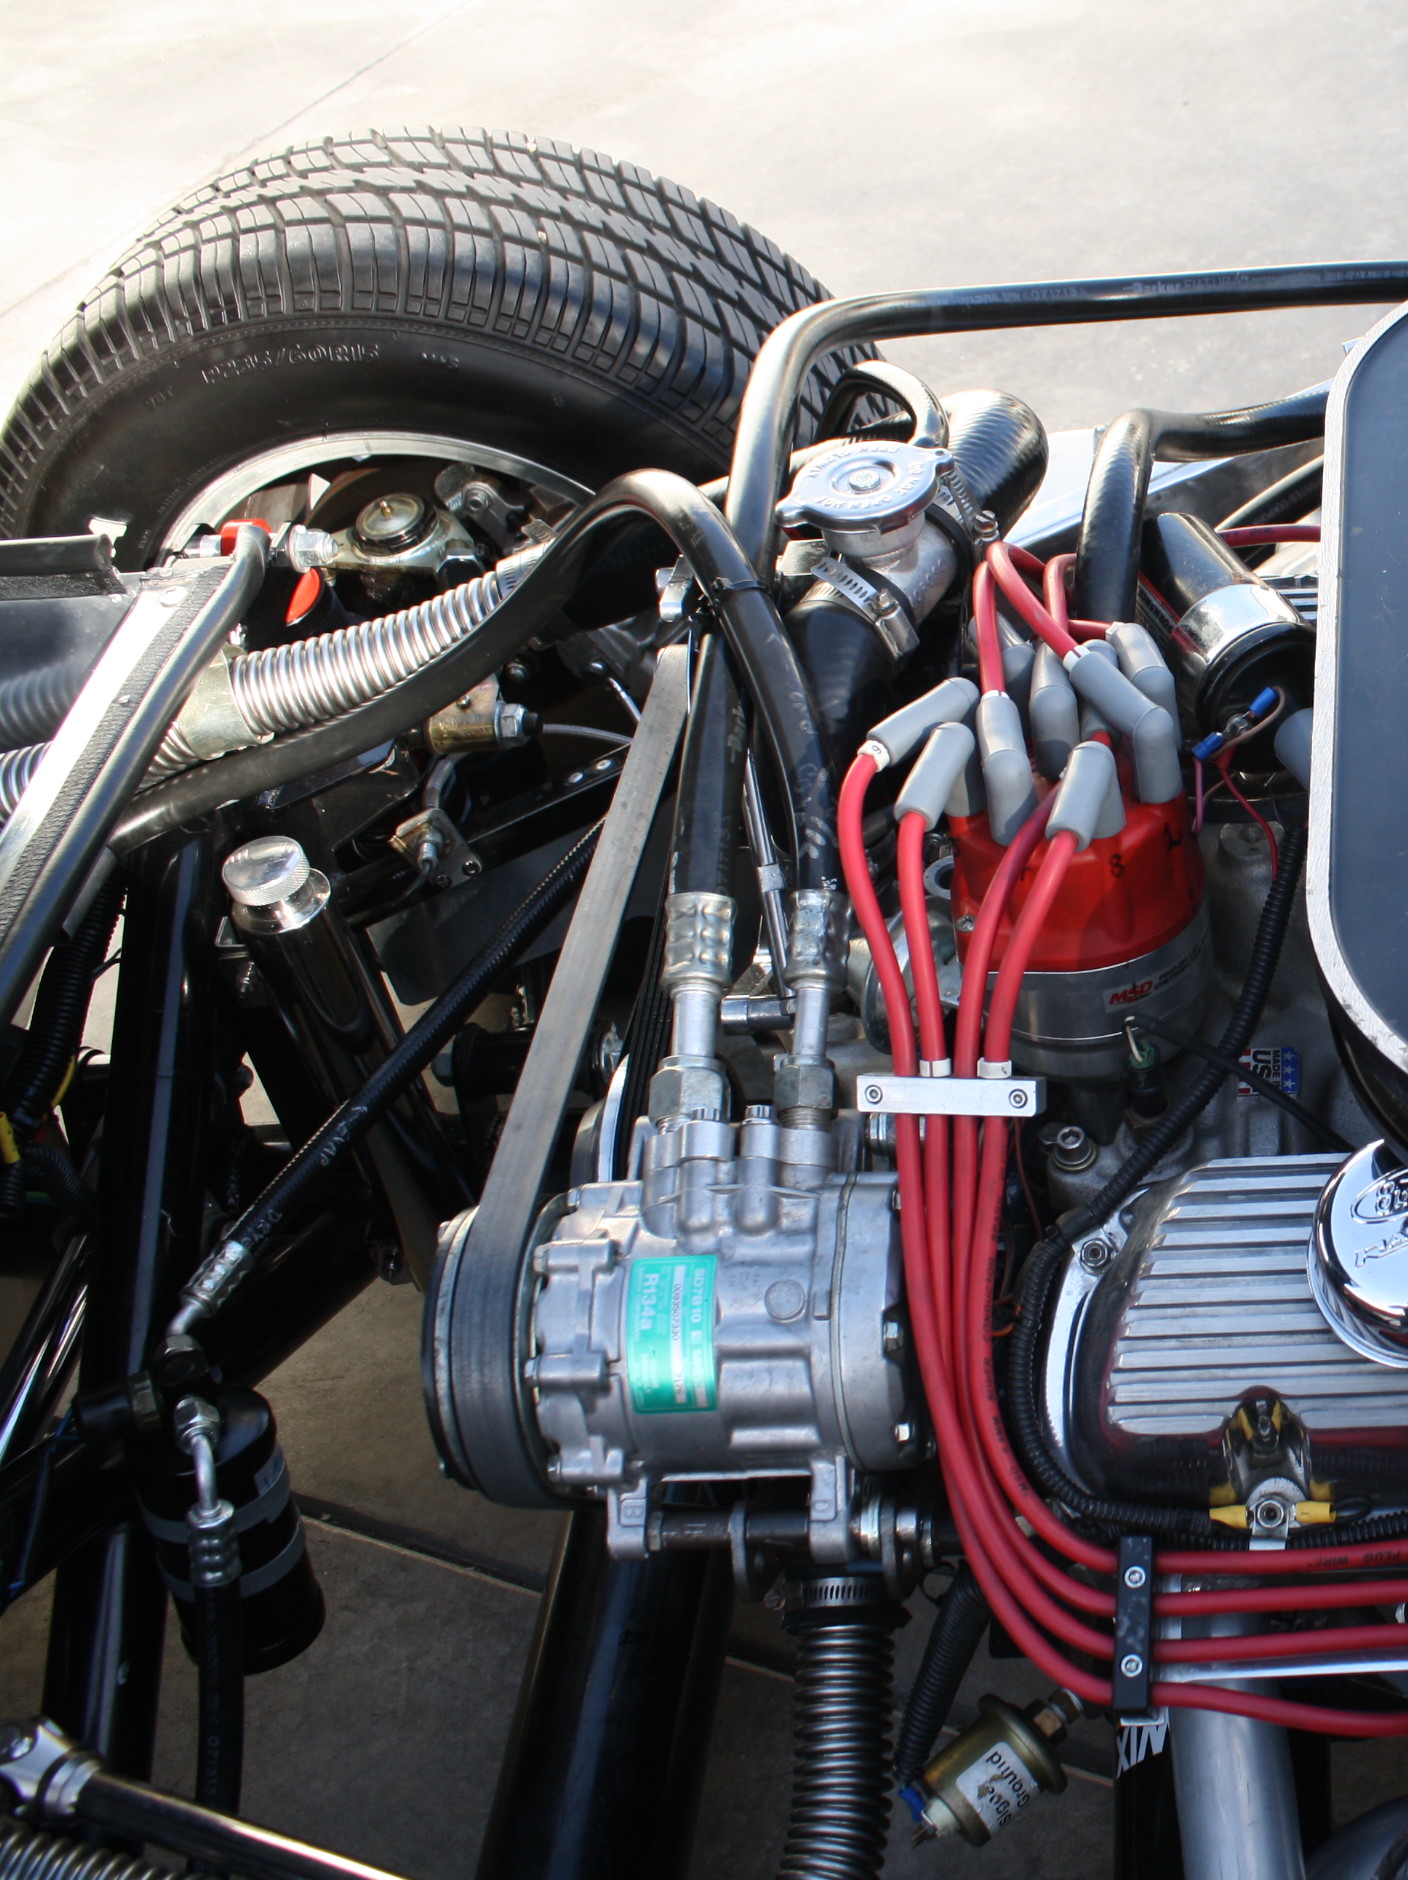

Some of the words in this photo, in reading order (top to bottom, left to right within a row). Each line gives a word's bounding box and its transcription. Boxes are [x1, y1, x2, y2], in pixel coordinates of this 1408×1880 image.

[200, 342, 380, 385] P235/60R15
[1109, 980, 1154, 1005] MSD
[1272, 1050, 1281, 1078] MADE
[639, 1272, 660, 1331] R134a
[1363, 1550, 1400, 1565] PLUG
